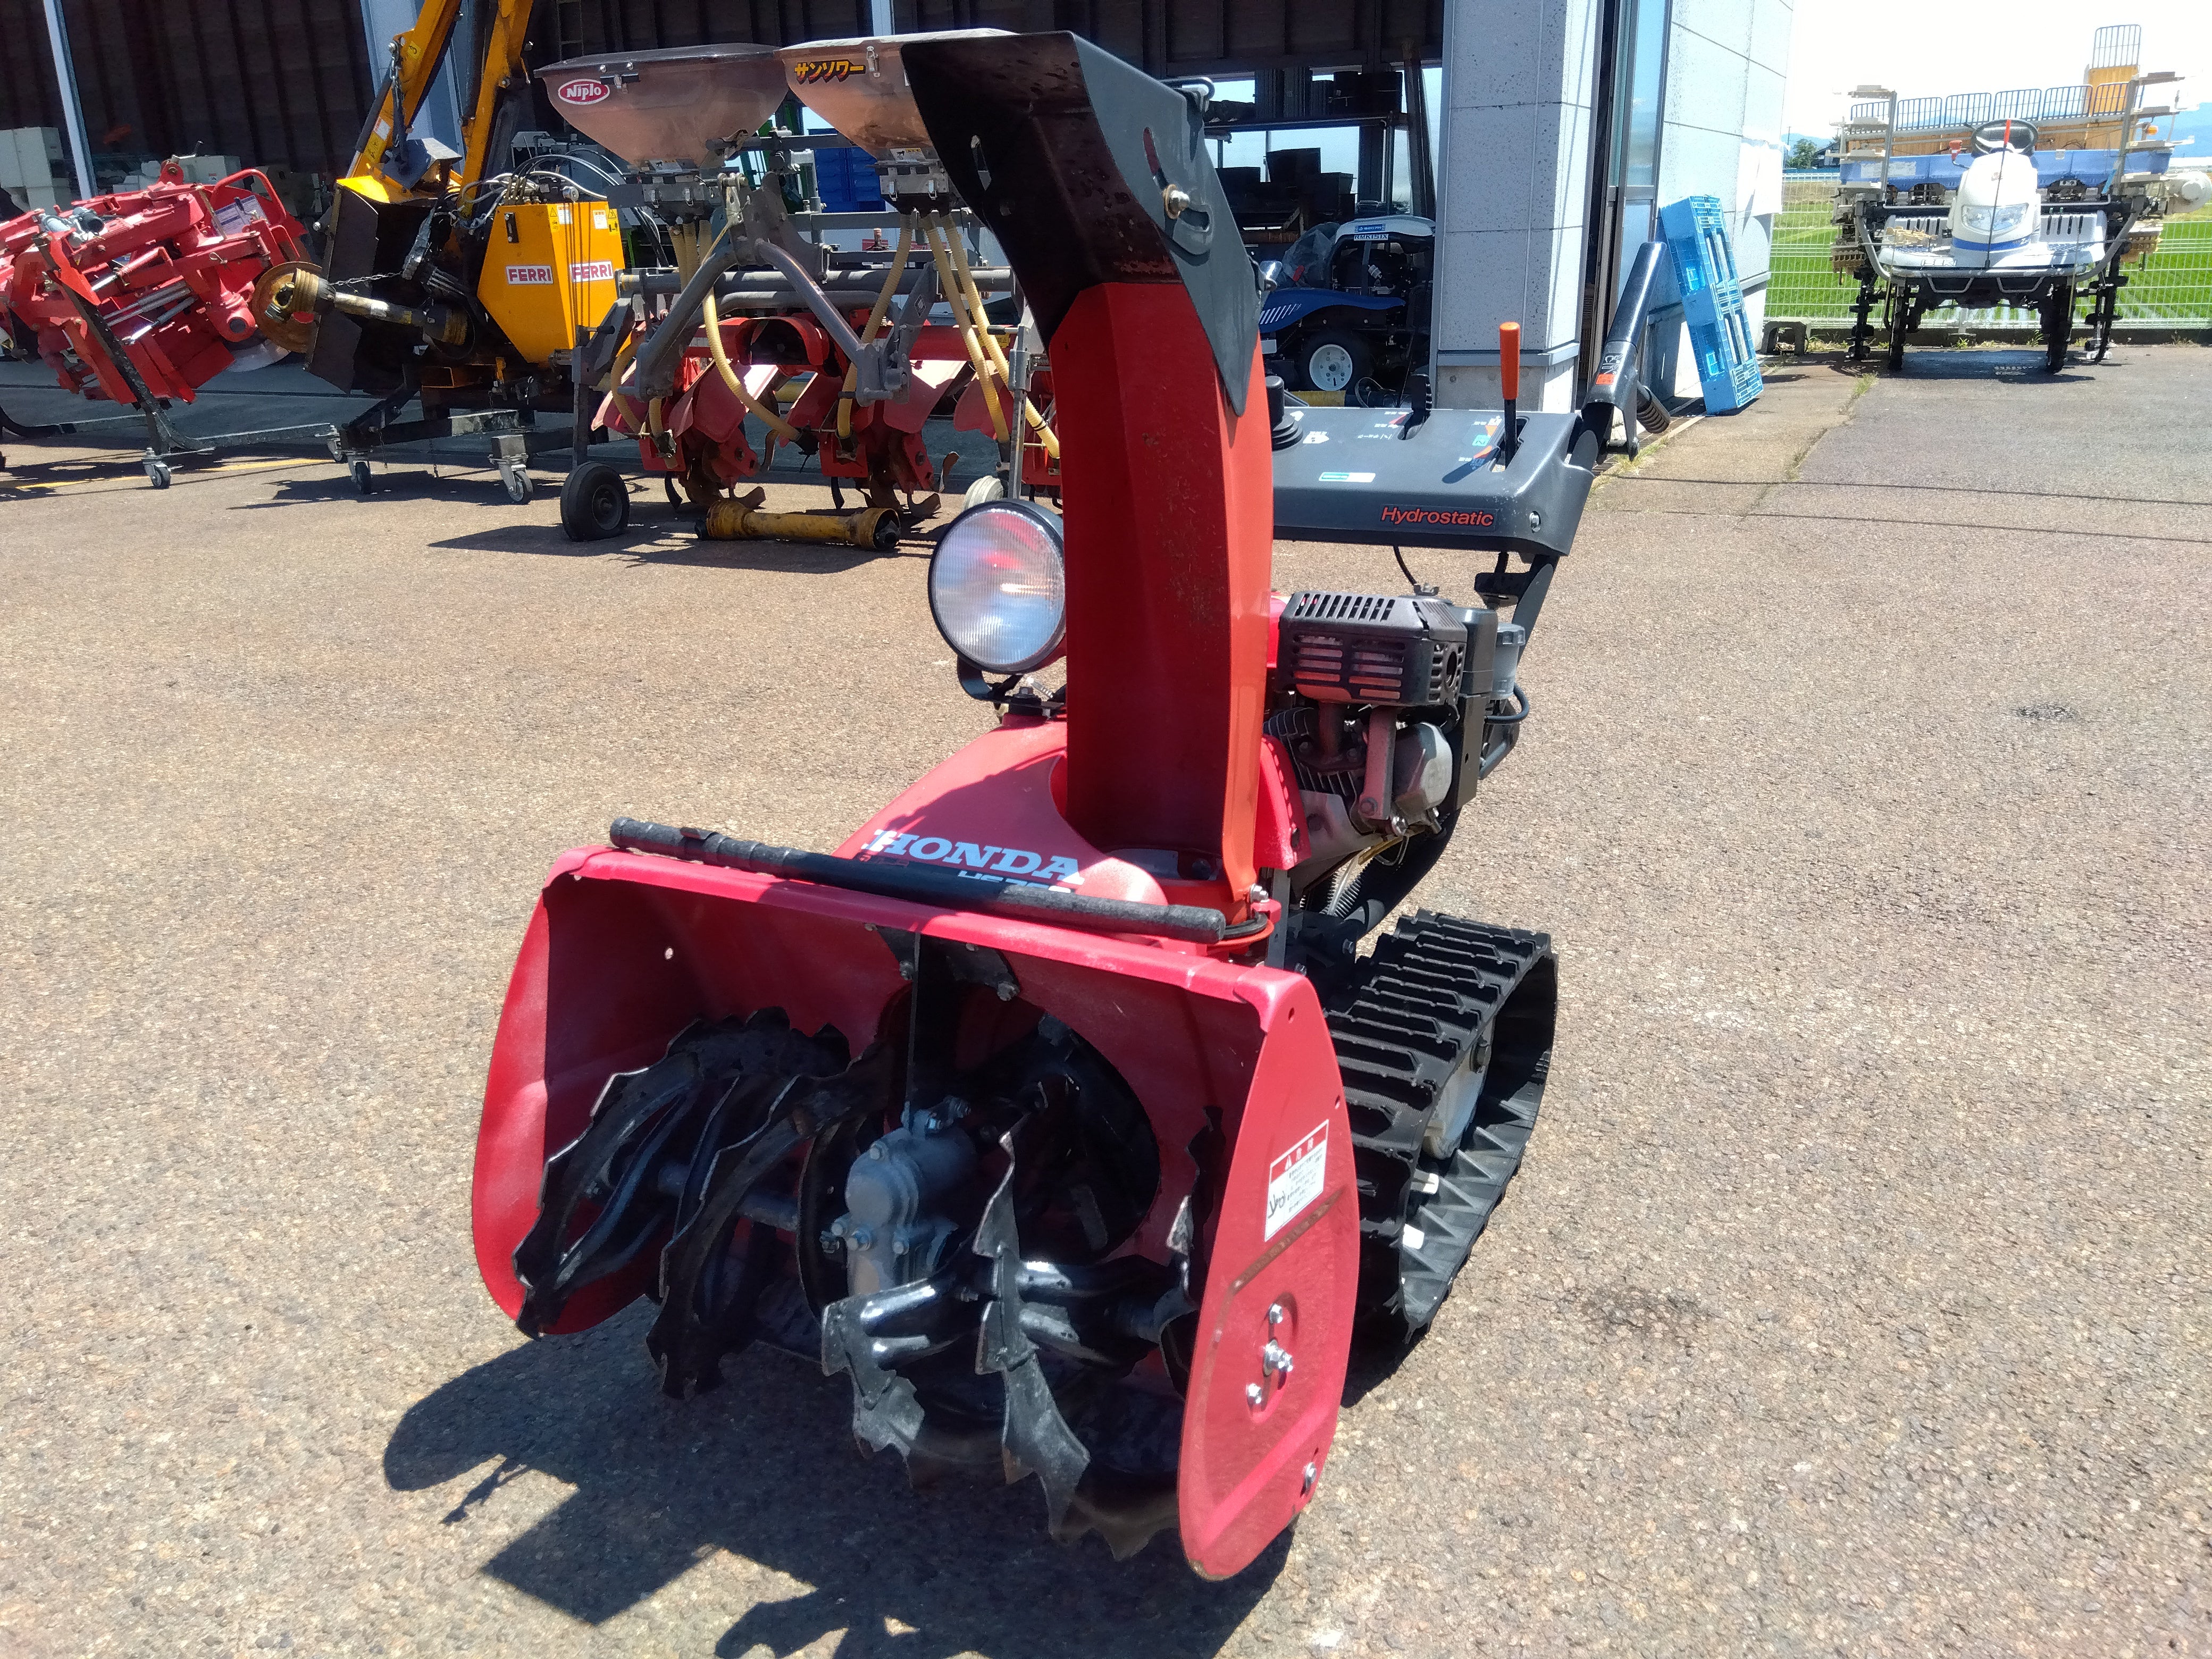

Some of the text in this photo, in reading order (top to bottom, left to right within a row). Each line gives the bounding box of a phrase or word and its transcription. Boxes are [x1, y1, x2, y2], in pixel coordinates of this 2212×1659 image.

[794, 60, 865, 82] サンソワー
[567, 83, 601, 100] Niplo
[508, 269, 551, 281] FERRI
[573, 264, 611, 280] FERRI
[1381, 507, 1494, 526] Hydrostatic
[861, 829, 1085, 885] HONDA
